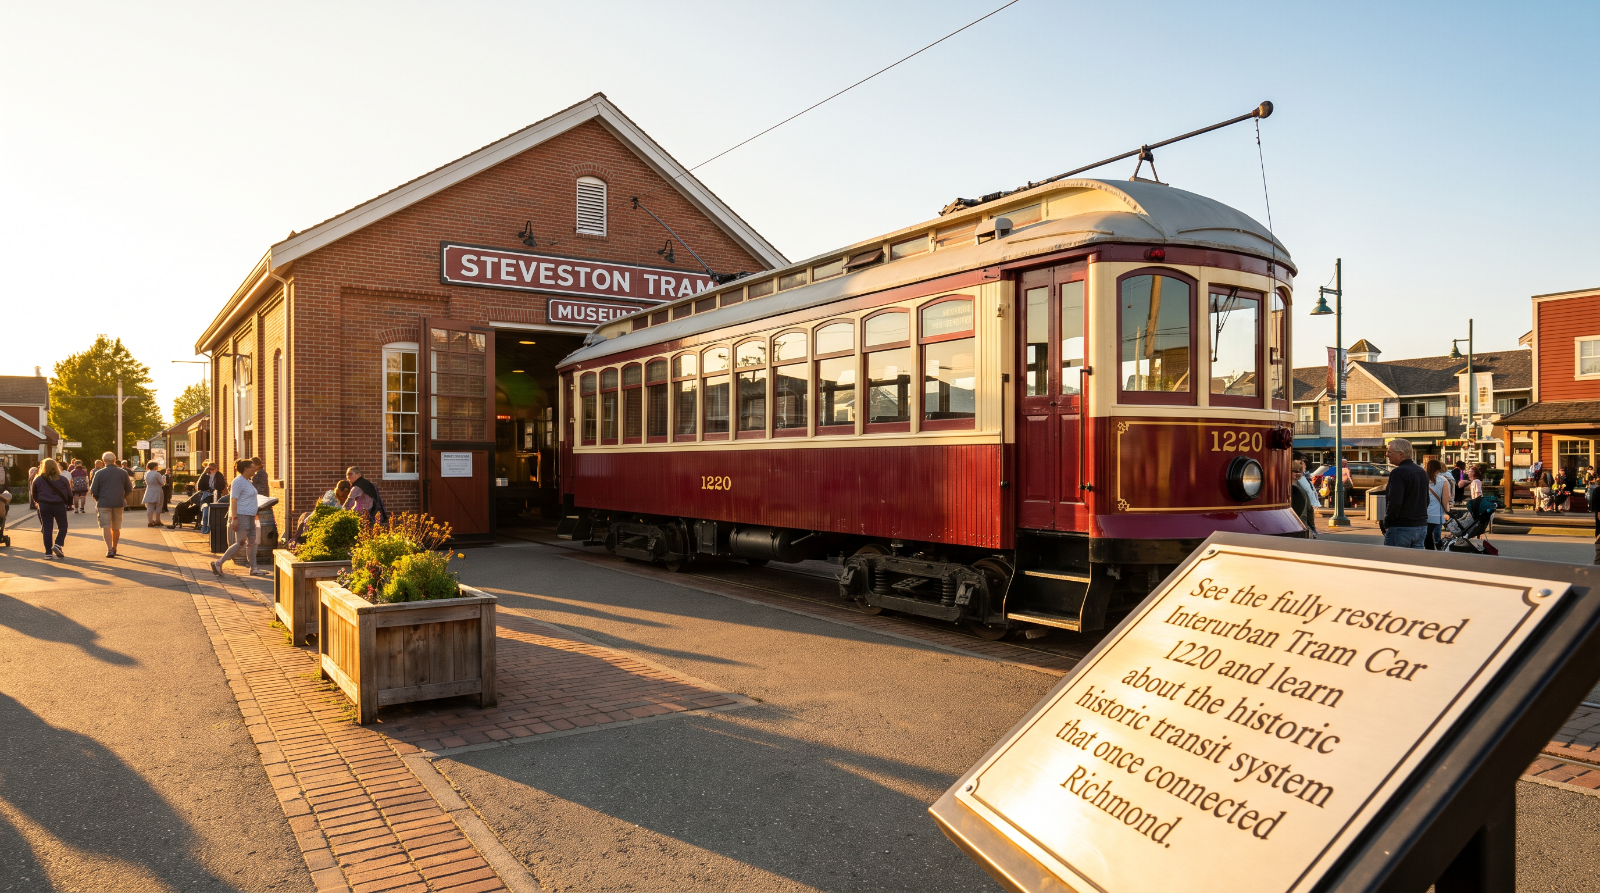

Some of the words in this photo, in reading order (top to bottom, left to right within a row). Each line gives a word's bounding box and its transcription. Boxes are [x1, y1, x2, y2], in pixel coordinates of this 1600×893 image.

[460, 254, 630, 293] STEVESTON
[1211, 430, 1263, 452] 1220
[701, 475, 732, 490] 1220
[1163, 605, 1280, 649] Interurban
[1284, 629, 1358, 667] Tram
[1364, 647, 1429, 682] Car
[1190, 577, 1229, 601] See
[1229, 584, 1268, 608] the
[1267, 590, 1333, 625] fully
[1331, 607, 1471, 645] restored
[1121, 666, 1187, 702] about
[1184, 686, 1226, 715] the
[1226, 697, 1341, 755] historic
[1162, 640, 1222, 671] 1220
[1218, 658, 1275, 686] and
[1266, 666, 1345, 709] learn
[1055, 719, 1098, 750] that
[1093, 741, 1146, 775] once
[1144, 765, 1288, 841] connected
[1075, 685, 1151, 731] historic
[1149, 717, 1235, 764] transit
[1228, 752, 1335, 809] system
[1059, 764, 1183, 849] Richmond.
